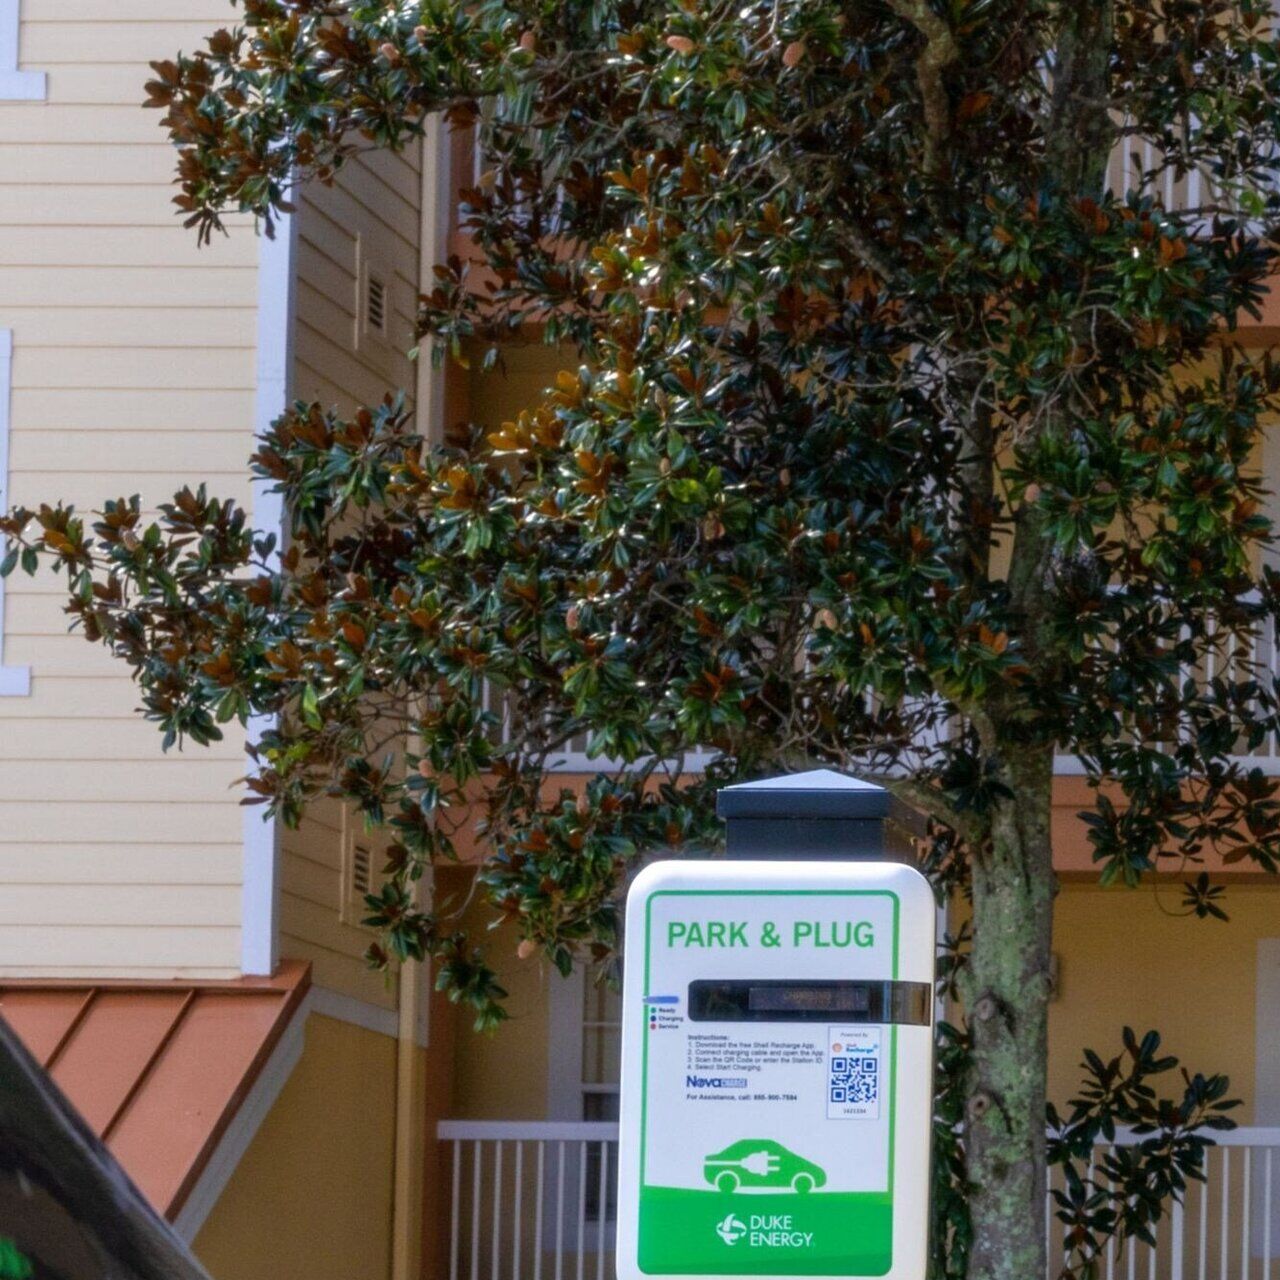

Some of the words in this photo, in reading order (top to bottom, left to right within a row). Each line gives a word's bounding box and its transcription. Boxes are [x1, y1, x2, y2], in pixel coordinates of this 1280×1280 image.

[668, 922, 748, 948] PARK
[760, 922, 781, 948] &
[794, 922, 875, 948] PLUG
[750, 1215, 792, 1230] DUKE
[750, 1232, 813, 1247] ENERGY
